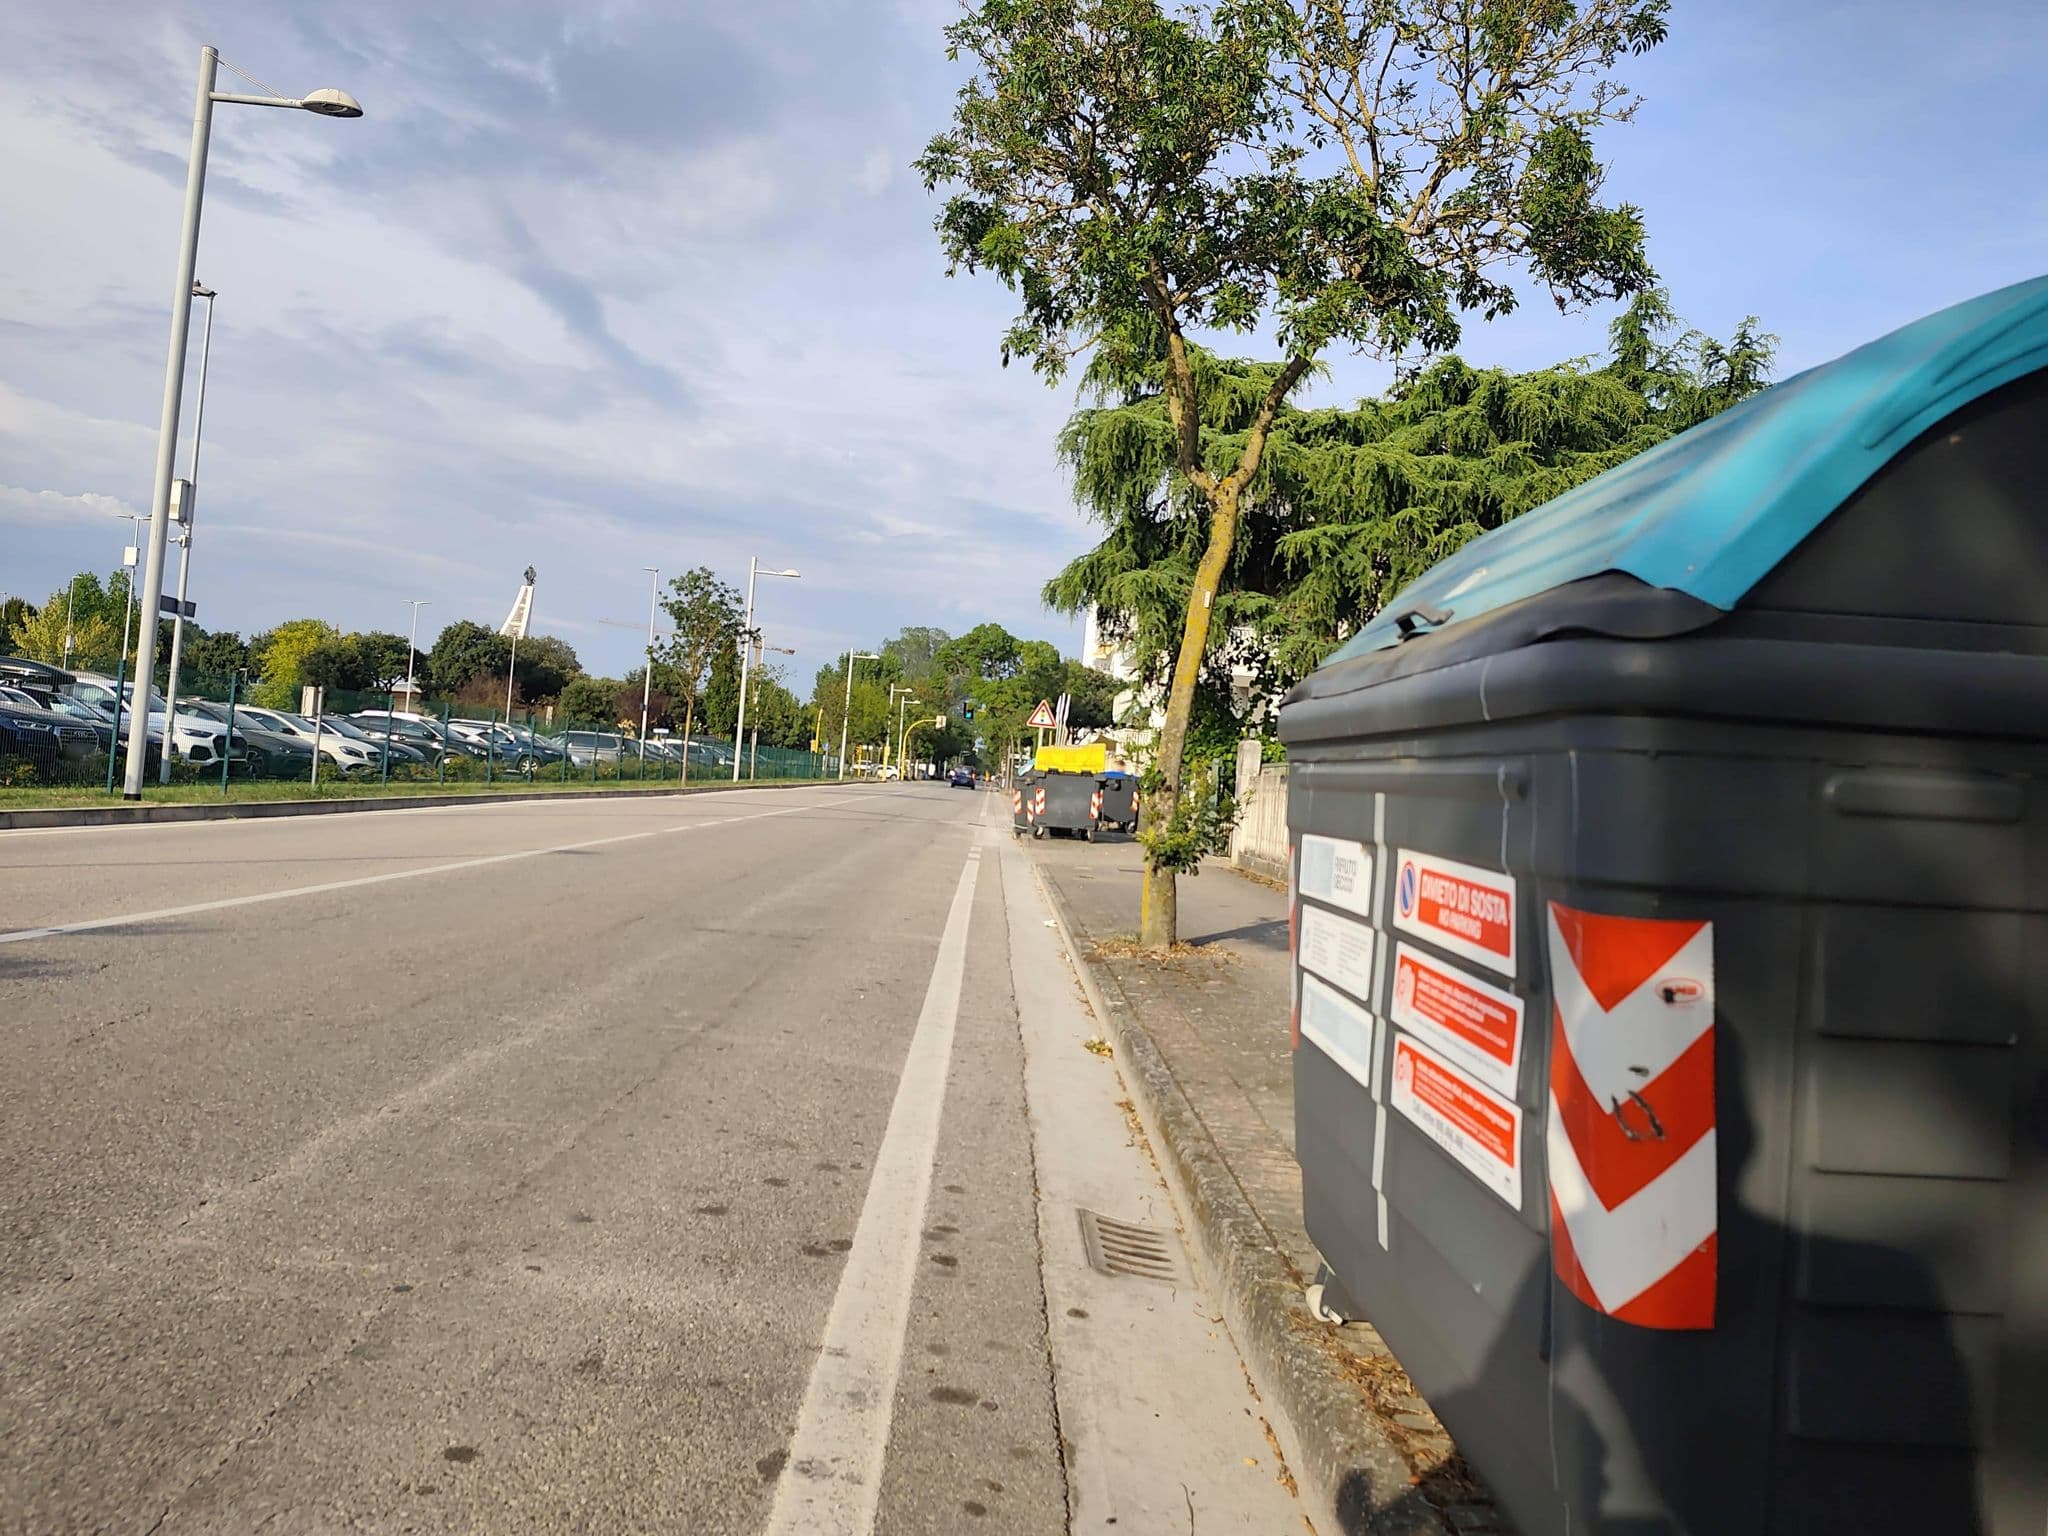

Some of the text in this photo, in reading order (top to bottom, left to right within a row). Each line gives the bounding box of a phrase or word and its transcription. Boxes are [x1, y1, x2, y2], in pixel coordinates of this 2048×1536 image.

[1421, 874, 1508, 927] DIVIETO DI SOSTA
